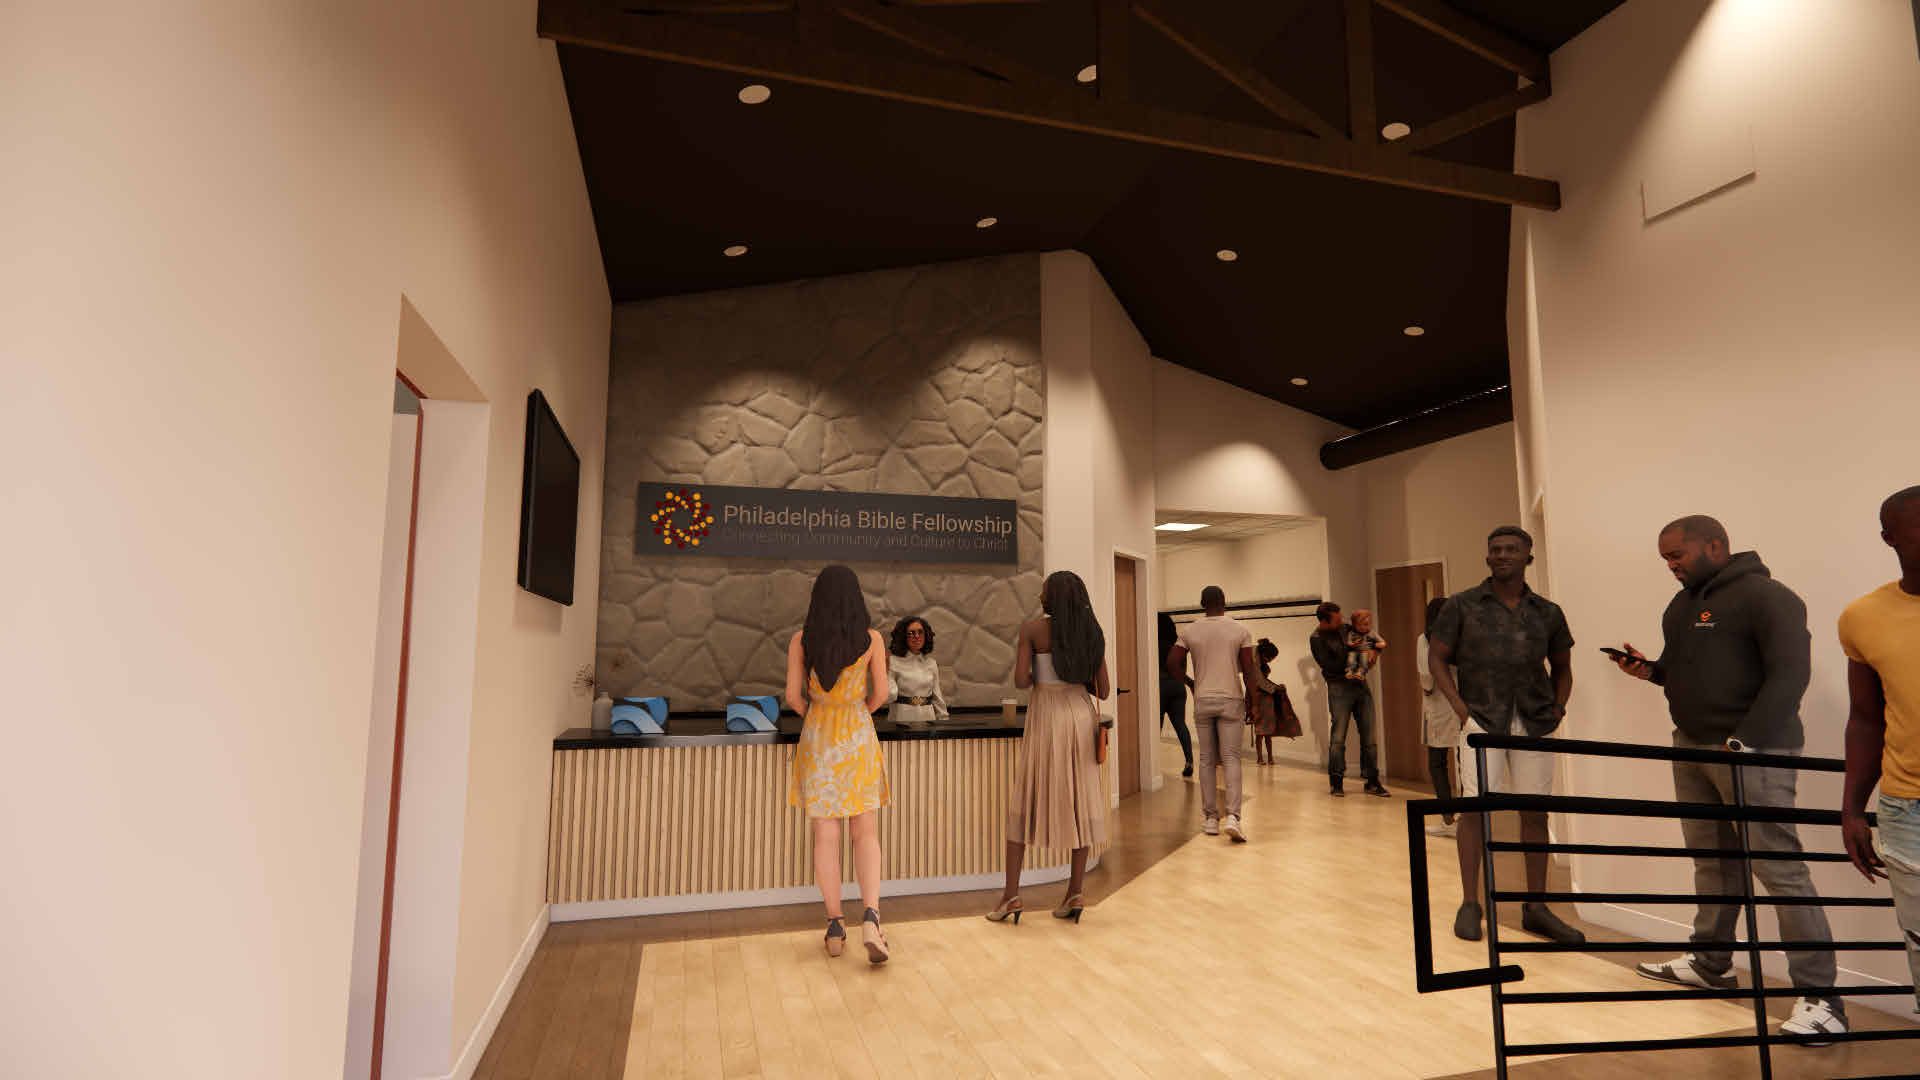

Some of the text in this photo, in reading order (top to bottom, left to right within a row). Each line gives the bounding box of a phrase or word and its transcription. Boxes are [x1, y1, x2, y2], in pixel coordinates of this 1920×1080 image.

[723, 504, 1013, 538] Philadelphia Bible Fellowship
